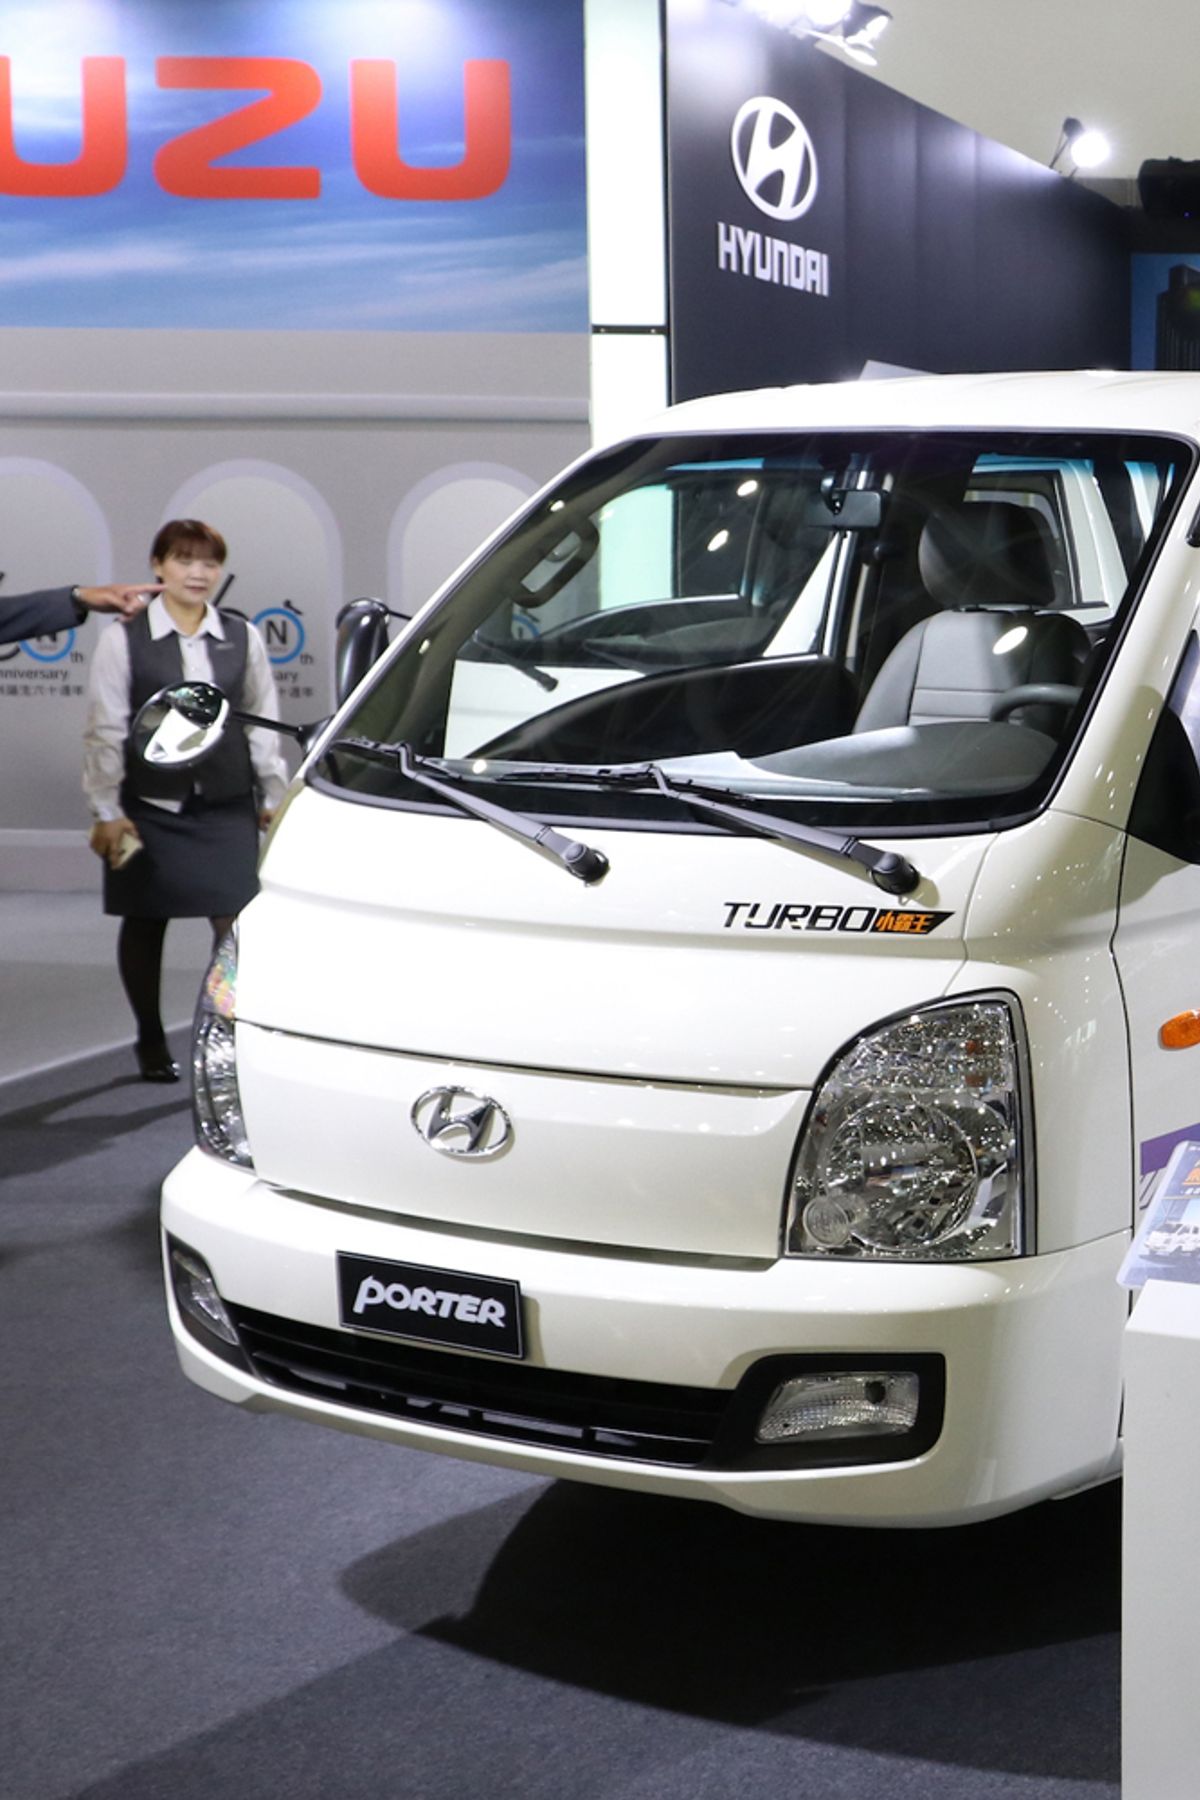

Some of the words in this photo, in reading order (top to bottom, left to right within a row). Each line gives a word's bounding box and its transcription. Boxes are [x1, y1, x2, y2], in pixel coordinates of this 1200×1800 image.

[717, 221, 830, 298] HYUNDAI
[723, 901, 878, 933] TURBO
[876, 911, 935, 933] 小霸王
[353, 1275, 506, 1328] PORTER
